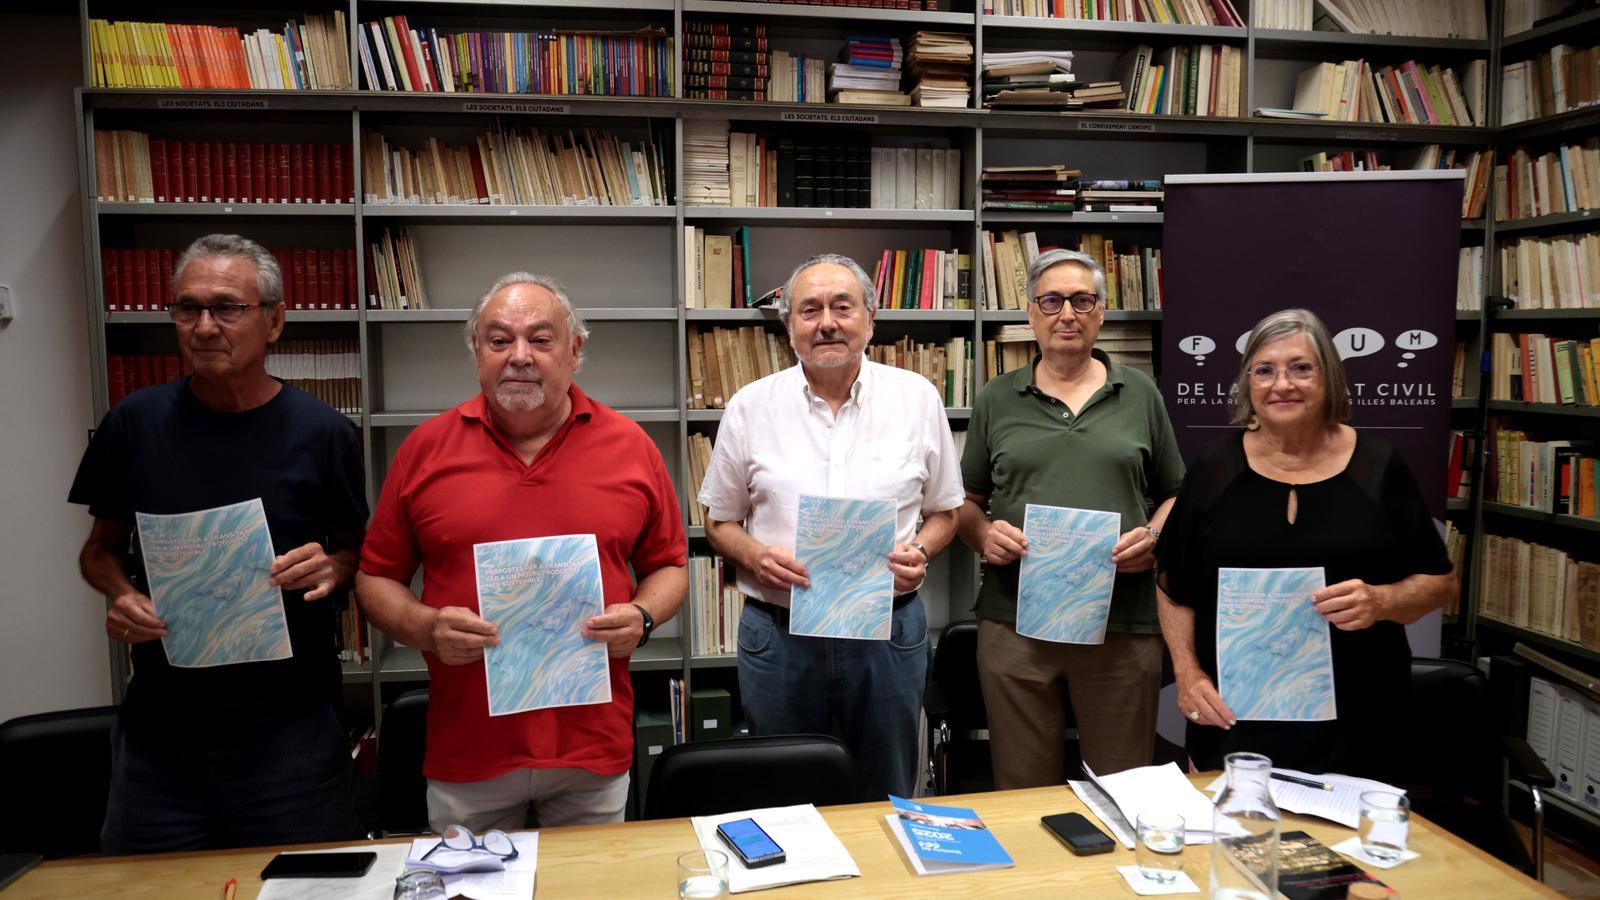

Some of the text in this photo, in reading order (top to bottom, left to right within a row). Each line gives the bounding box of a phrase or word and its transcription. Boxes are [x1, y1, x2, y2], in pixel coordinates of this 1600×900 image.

[1177, 383, 1205, 396] DE
[1217, 383, 1240, 396] LA
[1376, 383, 1436, 397] CIVIL
